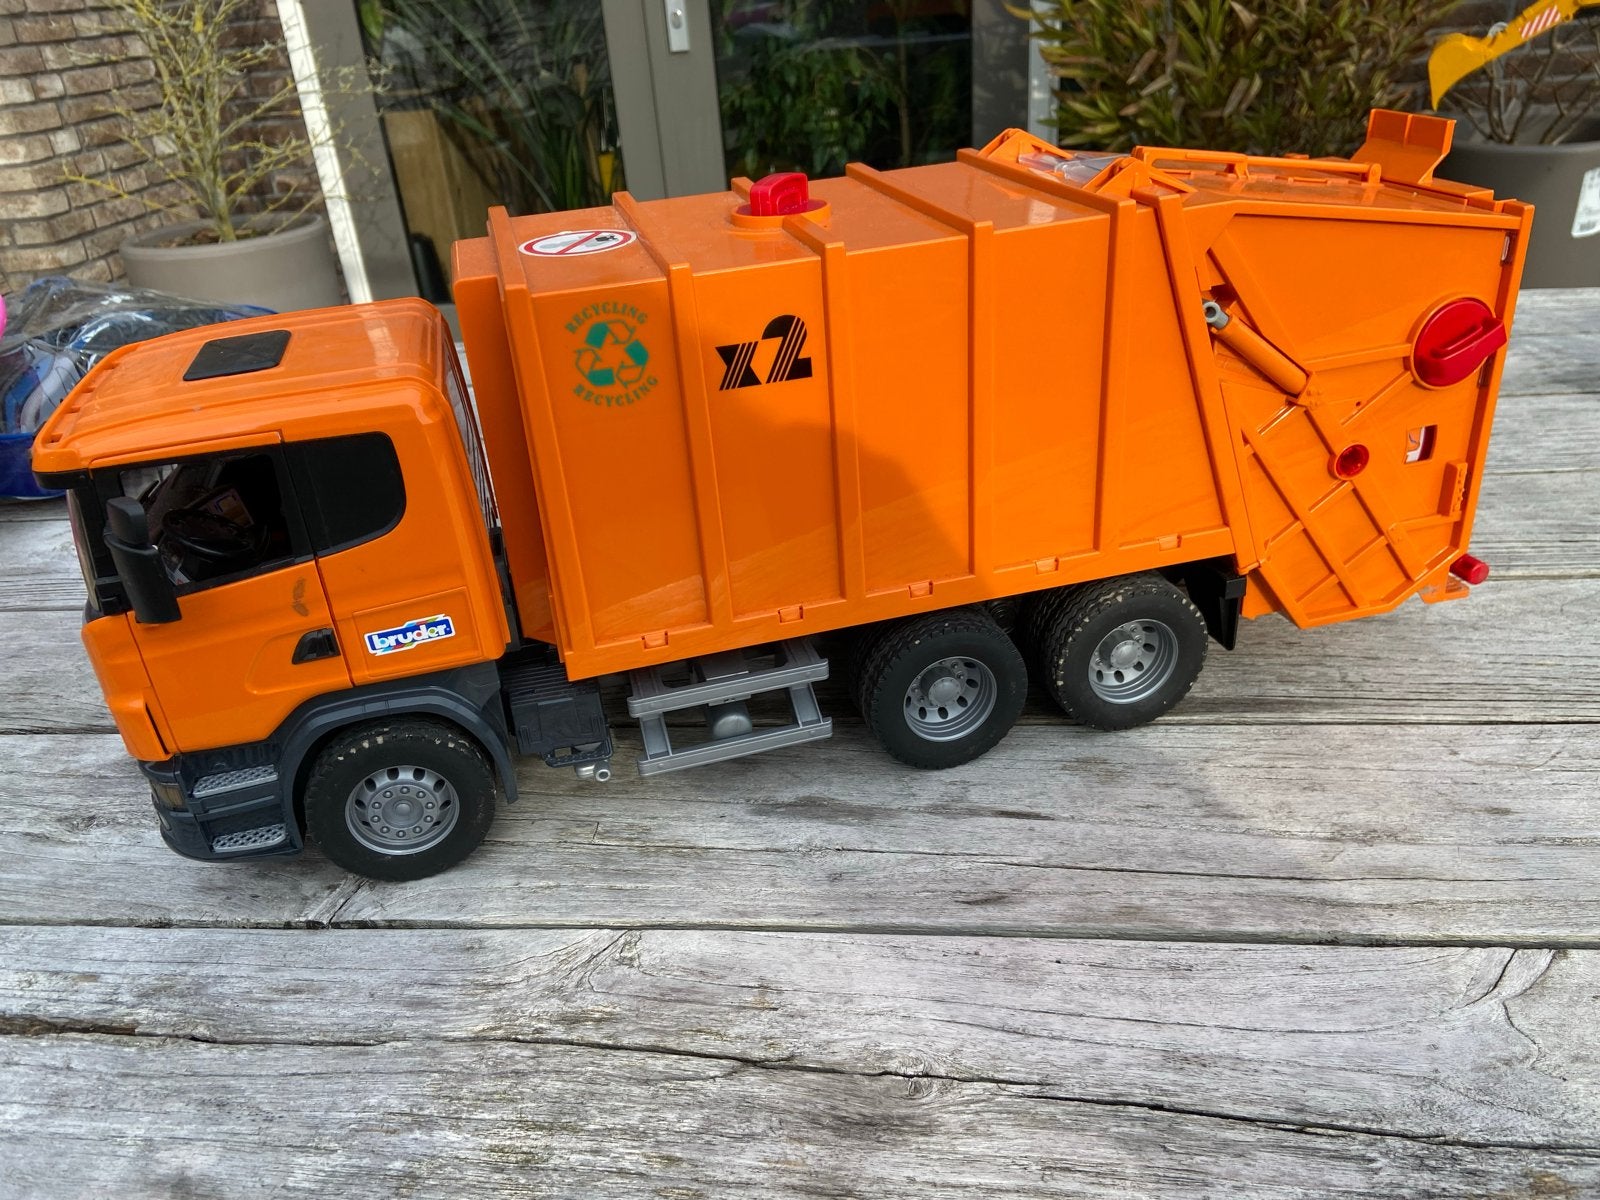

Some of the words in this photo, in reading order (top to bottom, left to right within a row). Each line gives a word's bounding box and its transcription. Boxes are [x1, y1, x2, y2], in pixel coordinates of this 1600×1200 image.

[565, 302, 648, 333] RECYCLING
[573, 376, 658, 407] RECYCLING
[372, 624, 447, 650] bruder
